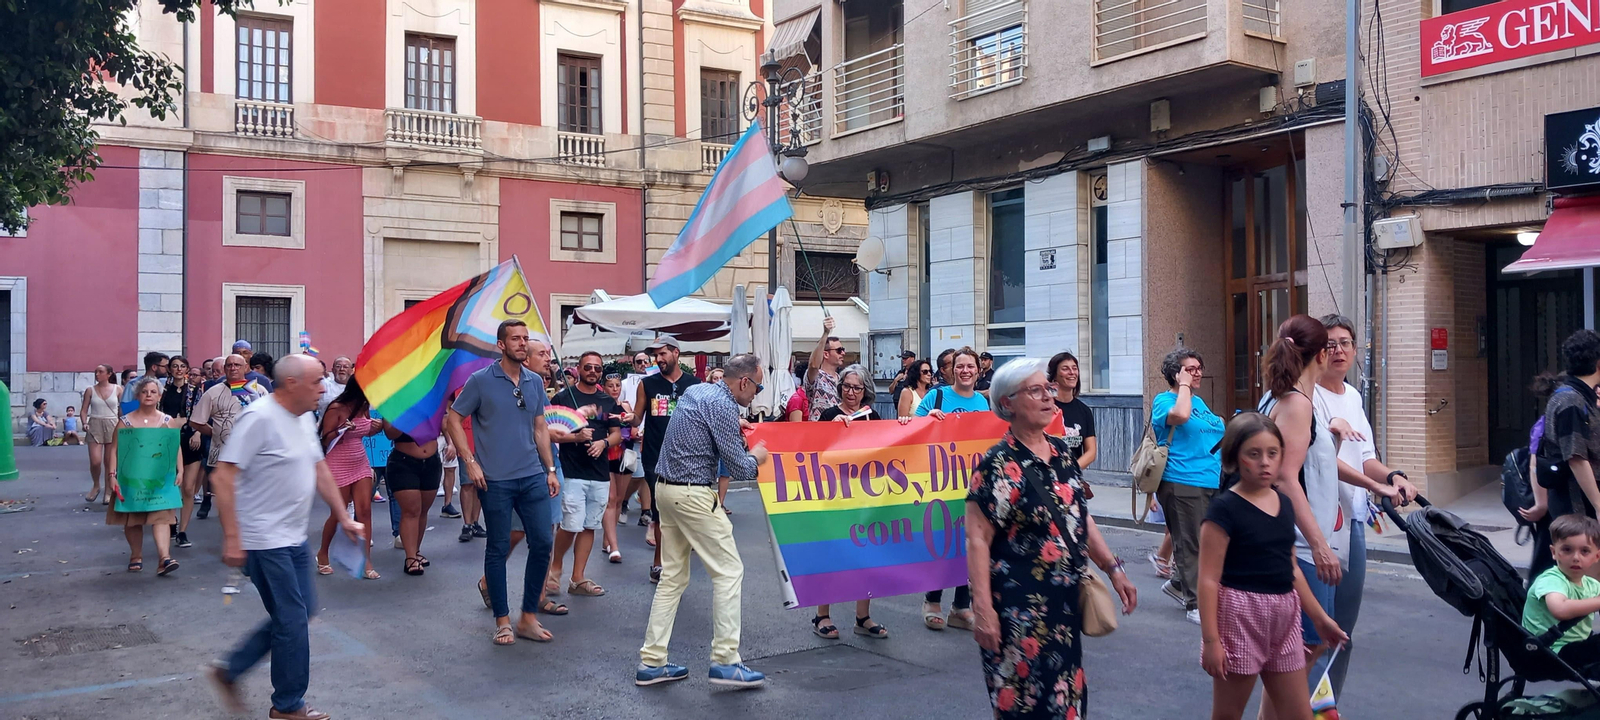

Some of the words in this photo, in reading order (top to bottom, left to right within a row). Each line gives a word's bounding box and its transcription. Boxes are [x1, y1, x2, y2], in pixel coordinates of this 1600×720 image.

[1498, 0, 1600, 49] GEN
[769, 451, 909, 503] Libres
[911, 480, 928, 506] y
[927, 442, 984, 492] Dive
[850, 517, 914, 547] con
[922, 498, 966, 560] Or
